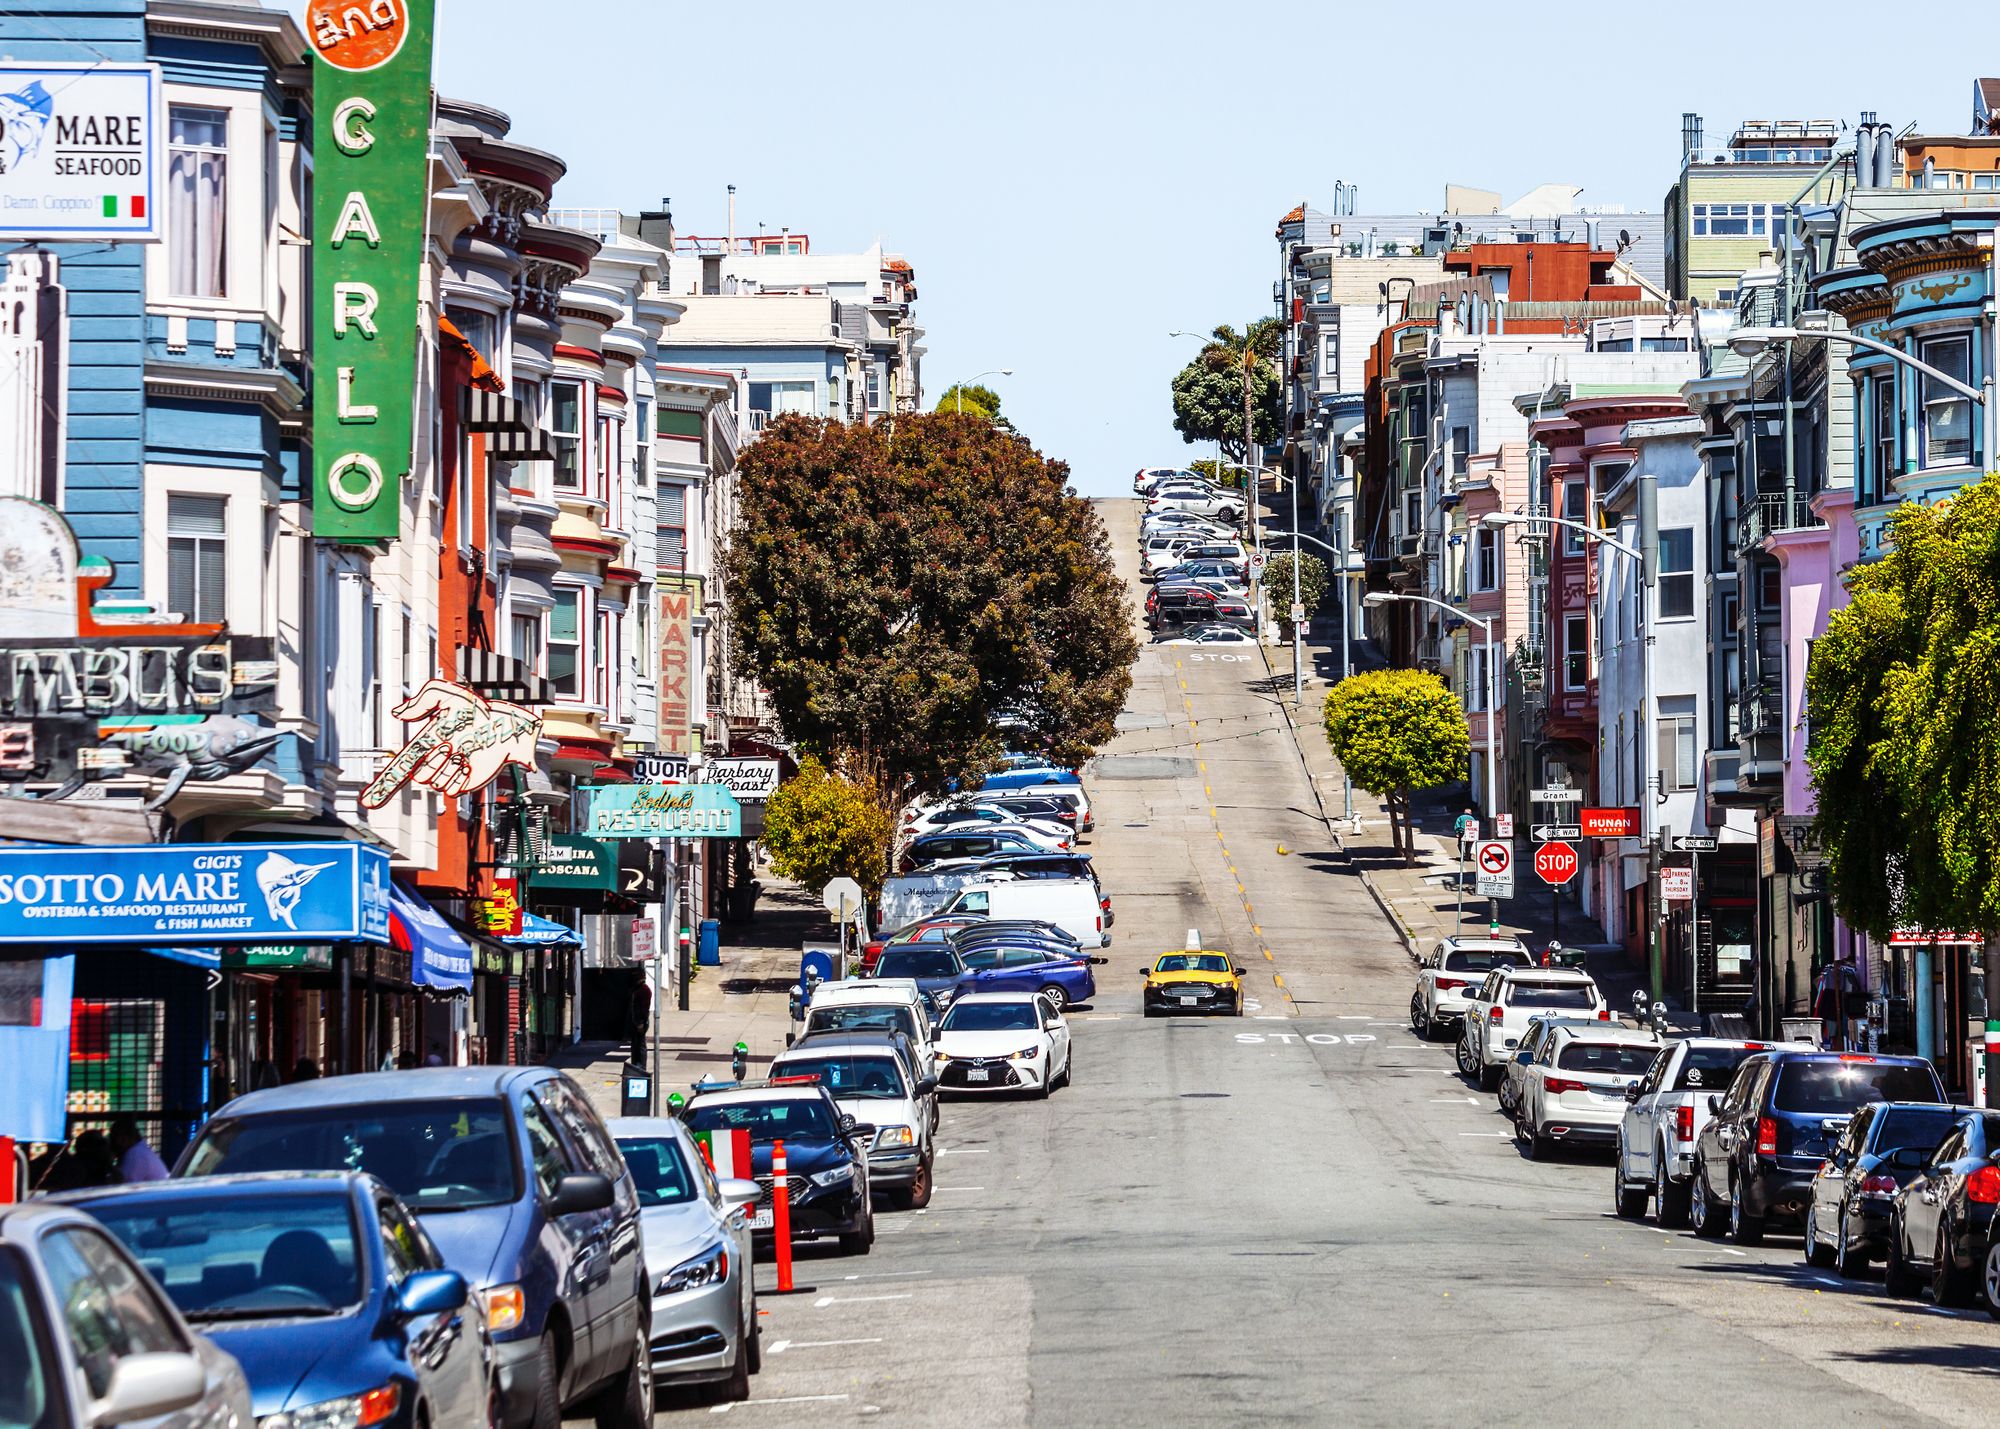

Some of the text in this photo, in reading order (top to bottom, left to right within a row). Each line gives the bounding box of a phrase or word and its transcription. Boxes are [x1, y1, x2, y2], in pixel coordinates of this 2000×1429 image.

[313, 0, 399, 47] and
[56, 115, 142, 146] MARE
[55, 158, 142, 176] SEAFOOD
[329, 97, 382, 510] CARLO
[1190, 653, 1252, 663] STOP
[3, 642, 233, 712] MBUS
[661, 596, 688, 752] MARKET
[597, 809, 732, 832] RESTAURANT
[1589, 819, 1631, 828] HUNAN
[1547, 829, 1577, 837] ONE WAY
[193, 855, 242, 870] GIGI'S
[1538, 854, 1574, 871] STOP
[0, 872, 240, 904] SOTTO MARE
[23, 903, 247, 918] OYSTERIA & SEAFOOD RESTAURANT
[154, 917, 254, 930] & FISH MARKET
[1234, 1033, 1377, 1045] STOP
